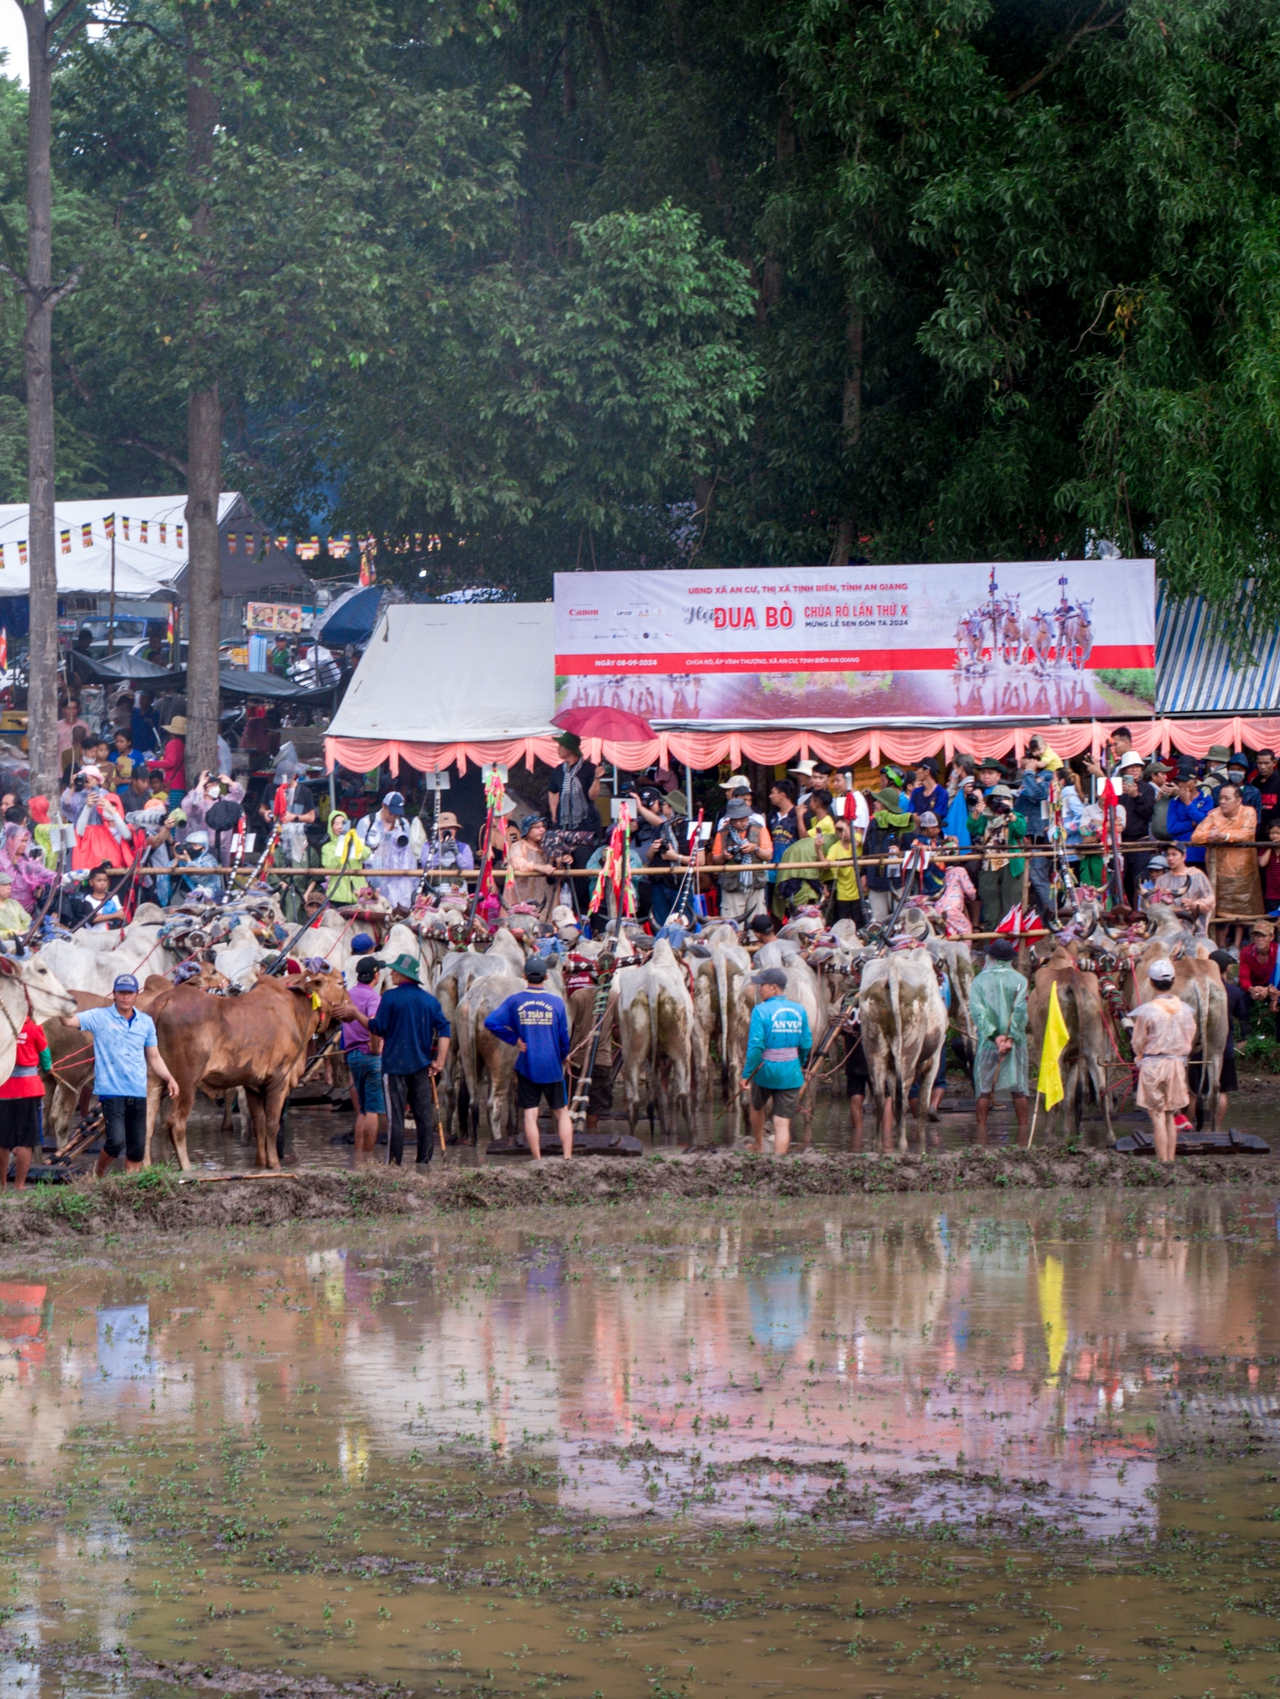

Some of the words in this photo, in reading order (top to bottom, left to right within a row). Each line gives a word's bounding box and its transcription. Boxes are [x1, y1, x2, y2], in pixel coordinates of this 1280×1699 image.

[688, 587, 713, 595] UBND
[715, 585, 727, 594] XÃ
[729, 586, 742, 594] AN
[762, 585, 776, 594] THỊ
[778, 584, 791, 593] XÃ
[879, 583, 908, 591] GIANG
[569, 608, 599, 616] Canon
[714, 607, 757, 629] ĐUA
[765, 600, 794, 629] BÒ
[901, 604, 908, 616] X
[842, 620, 857, 628] SEN
[595, 658, 616, 667] NGÀY
[616, 658, 658, 667] 08-09-2024
